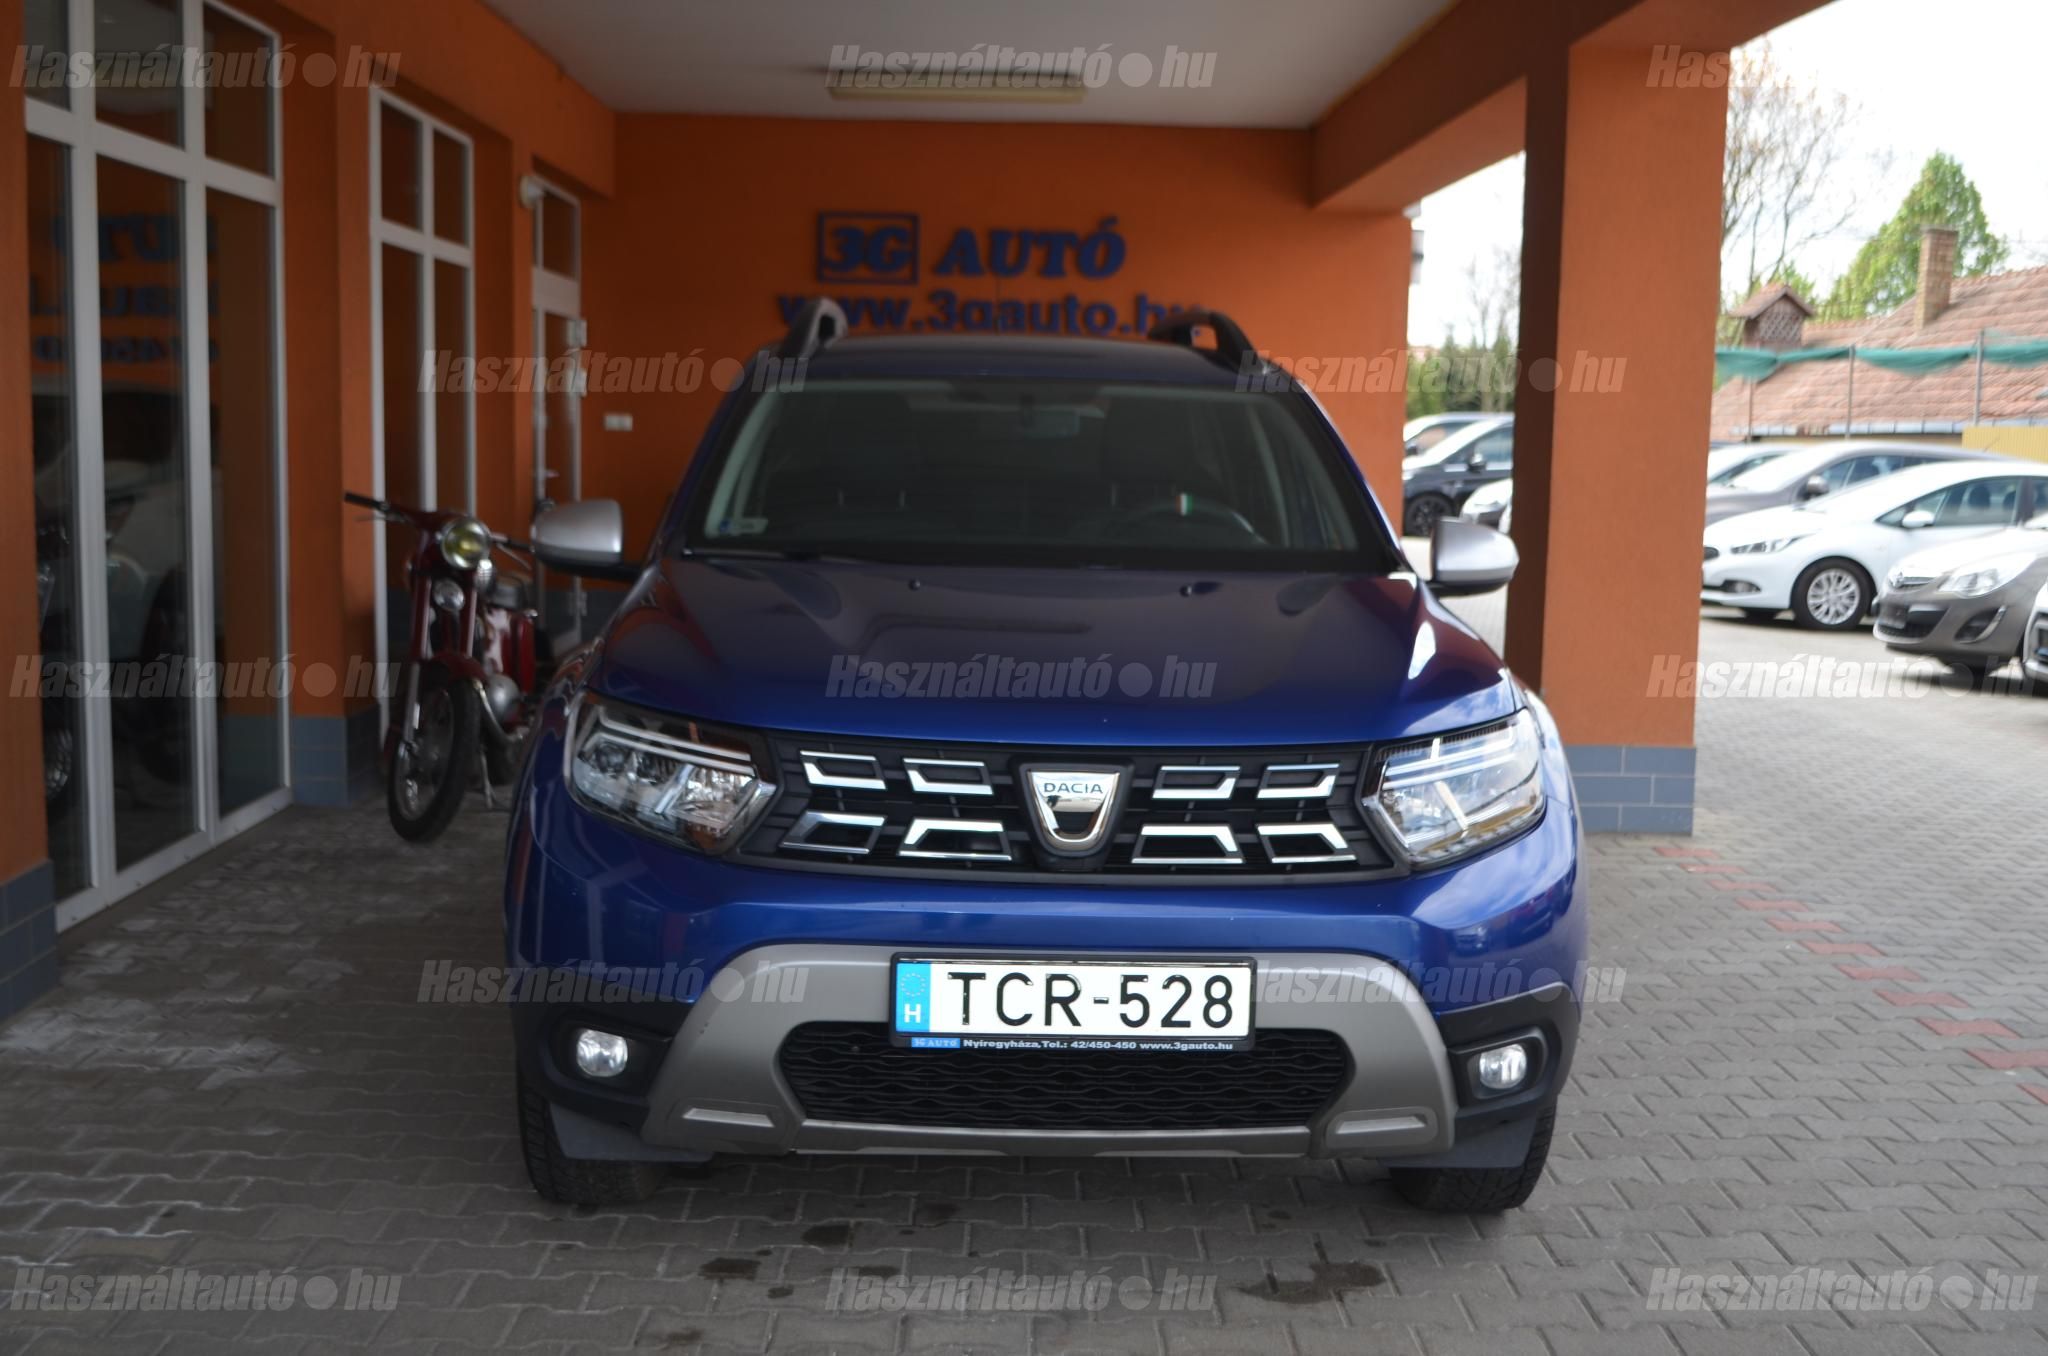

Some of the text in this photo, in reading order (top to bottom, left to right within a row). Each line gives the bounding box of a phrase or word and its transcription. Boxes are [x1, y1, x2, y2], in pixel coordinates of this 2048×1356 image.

[824, 215, 1126, 280] 3G AUTÓ
[1043, 782, 1104, 794] DACIA
[946, 971, 1234, 1029] TCR-528
[903, 1003, 922, 1024] H
[1070, 1041, 1137, 1050] 42/450-450
[1139, 1041, 1233, 1051] www.3gauto.hu
